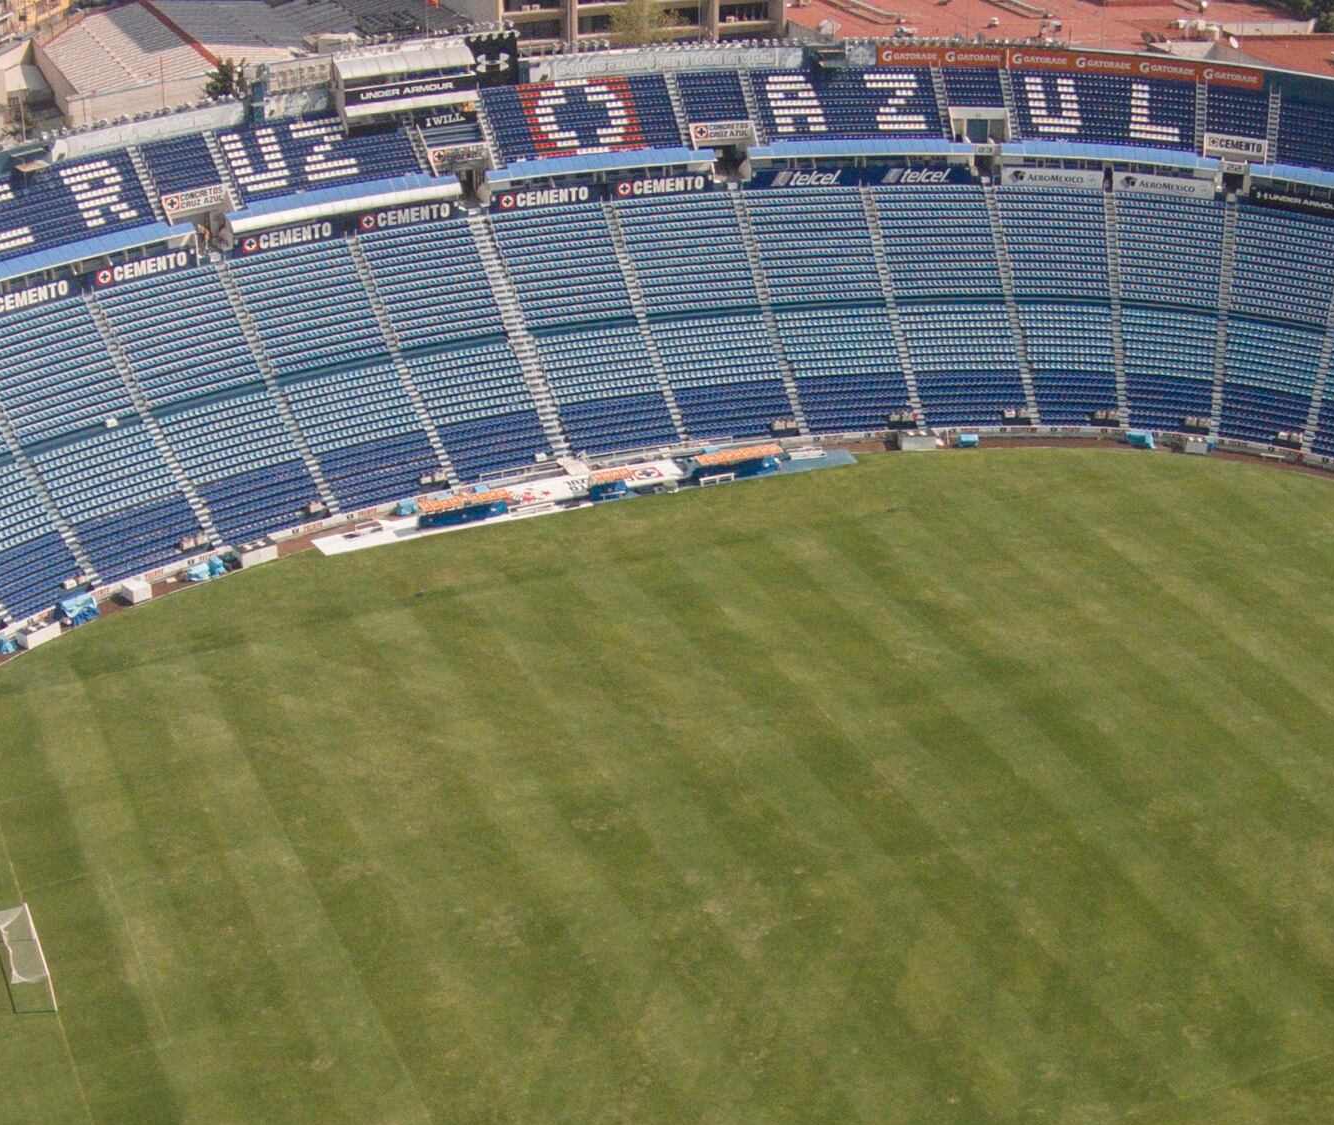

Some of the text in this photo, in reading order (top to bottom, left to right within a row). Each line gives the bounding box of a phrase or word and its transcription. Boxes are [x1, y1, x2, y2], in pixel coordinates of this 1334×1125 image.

[893, 52, 938, 62] GATORADE
[956, 53, 1001, 63] GATORADE
[1023, 55, 1067, 66] GATORADE
[1087, 60, 1131, 70] GATORADE
[1150, 65, 1195, 76] GATORADE
[1214, 71, 1259, 83] GATORADE
[360, 82, 454, 100] UNDER ARMOUR
[766, 74, 1180, 142] AZUL
[1219, 138, 1263, 154] CEMENTO
[789, 169, 841, 187] telcel
[900, 168, 950, 184] telcel
[180, 185, 224, 203] CONCRETOS
[632, 176, 705, 197] CEMENTO
[517, 186, 589, 207] CEMENTO
[377, 203, 450, 227] CEMENTO
[259, 223, 332, 249] CEMENTO
[113, 251, 187, 282] CEMENTO
